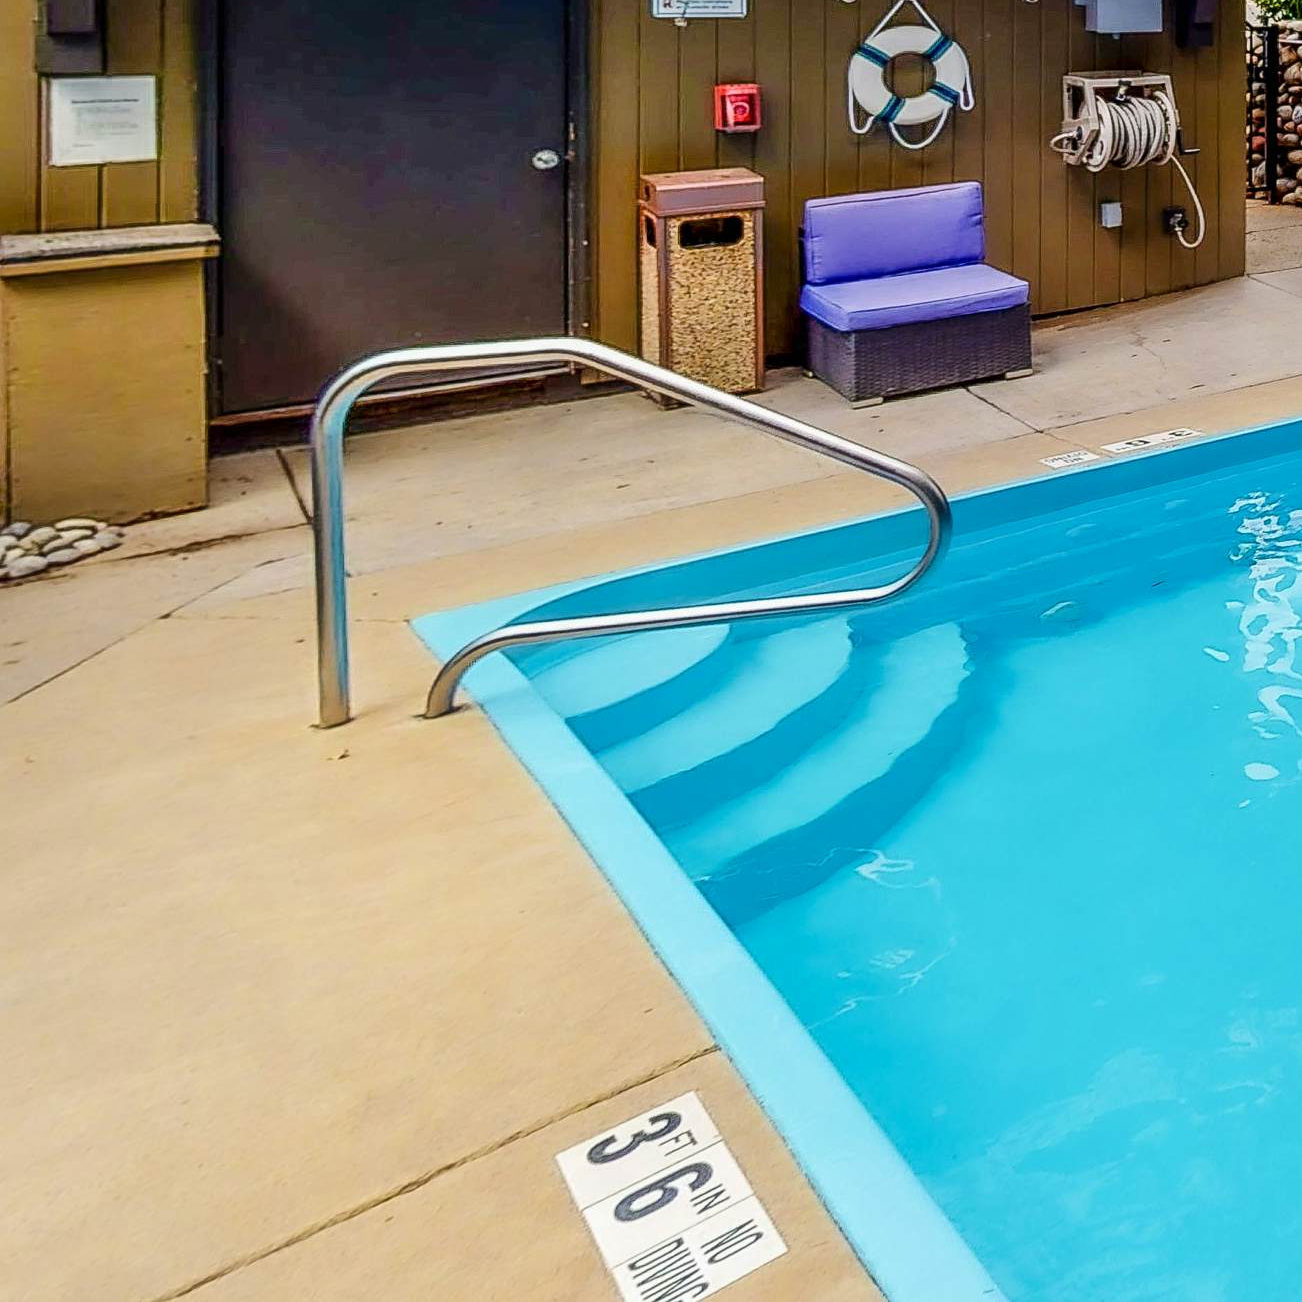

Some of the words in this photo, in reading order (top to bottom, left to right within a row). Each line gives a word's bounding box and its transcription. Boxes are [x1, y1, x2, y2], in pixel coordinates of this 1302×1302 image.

[586, 1111, 682, 1165] 3
[658, 1130, 698, 1157] FT
[614, 1162, 714, 1223] 6
[690, 1183, 731, 1215] IN
[700, 1219, 764, 1265] NO
